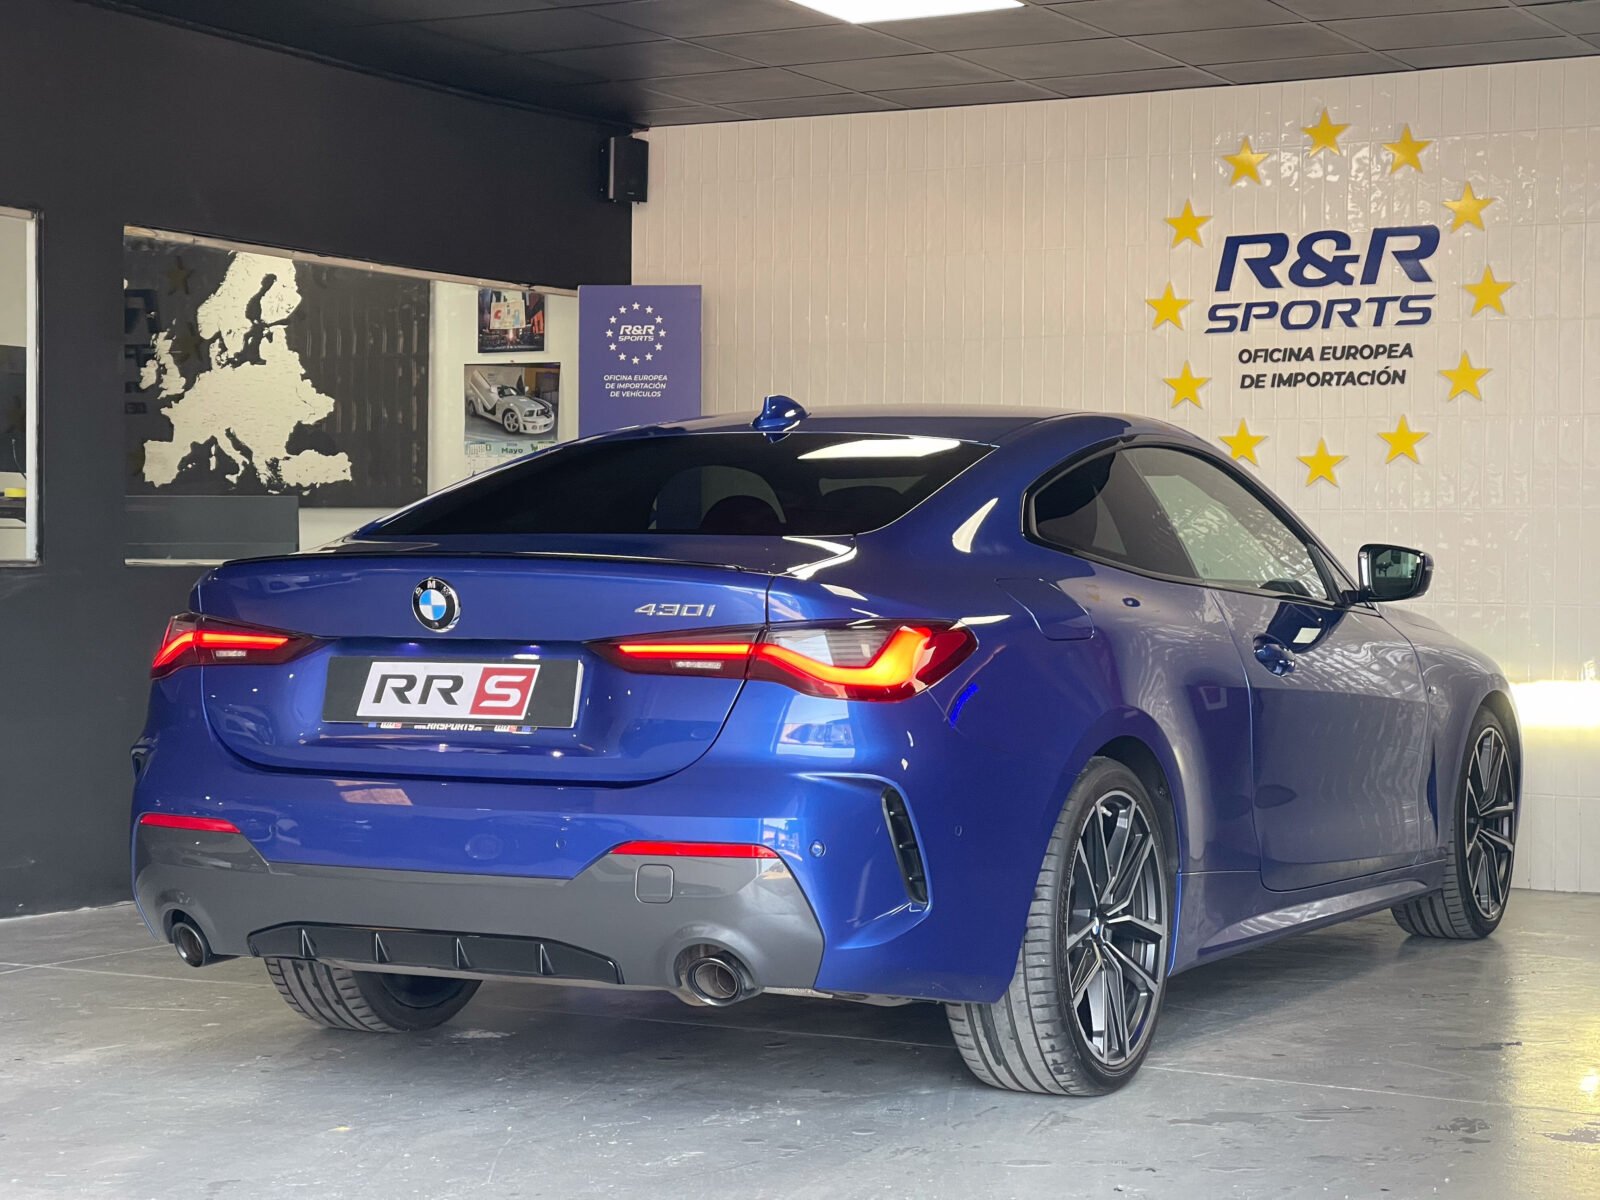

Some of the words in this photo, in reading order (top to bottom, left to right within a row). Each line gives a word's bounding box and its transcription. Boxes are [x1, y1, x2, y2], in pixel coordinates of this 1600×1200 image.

[1214, 224, 1441, 292] R&R
[1204, 294, 1437, 334] SPORTS
[619, 325, 655, 335] R&R
[1238, 347, 1315, 365] OFICINA
[1319, 342, 1414, 361] EUROPEA
[616, 381, 667, 389] IMPORTACIÓN
[1239, 373, 1266, 389] DE
[1270, 366, 1407, 388] IMPORTACIÓN
[621, 389, 662, 397] VEHÍCULOS
